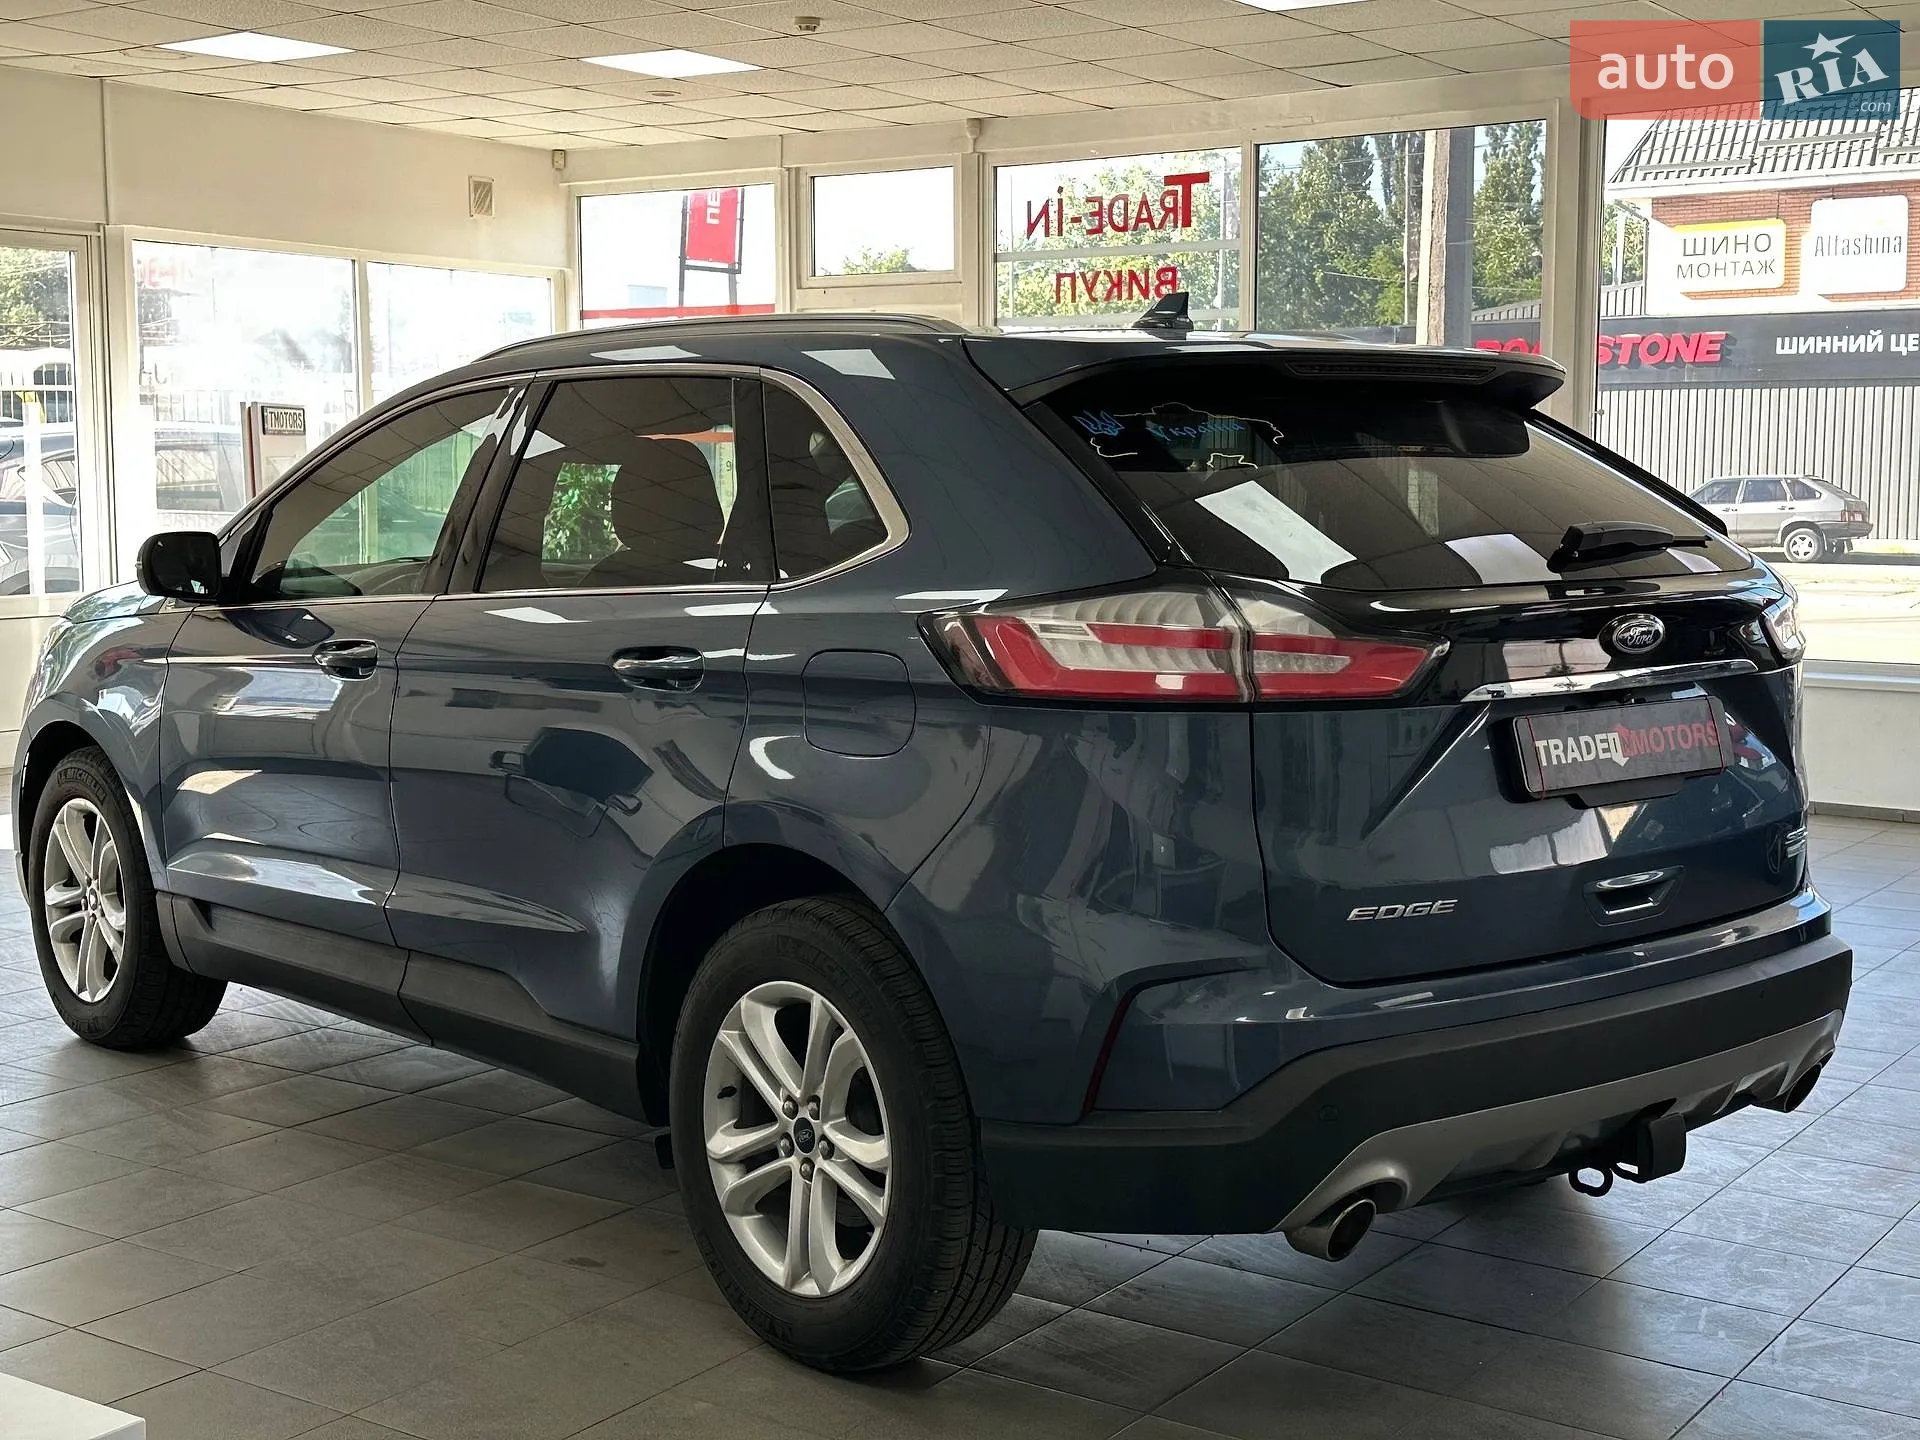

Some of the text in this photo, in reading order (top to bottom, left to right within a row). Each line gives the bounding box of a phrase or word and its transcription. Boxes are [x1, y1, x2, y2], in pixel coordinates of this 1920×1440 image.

[1682, 233, 1772, 257] ШИНО
[1676, 258, 1776, 279] МОНТАЖ
[1775, 329, 1884, 355] ШИННИЙ
[1346, 899, 1459, 921] EDGE
